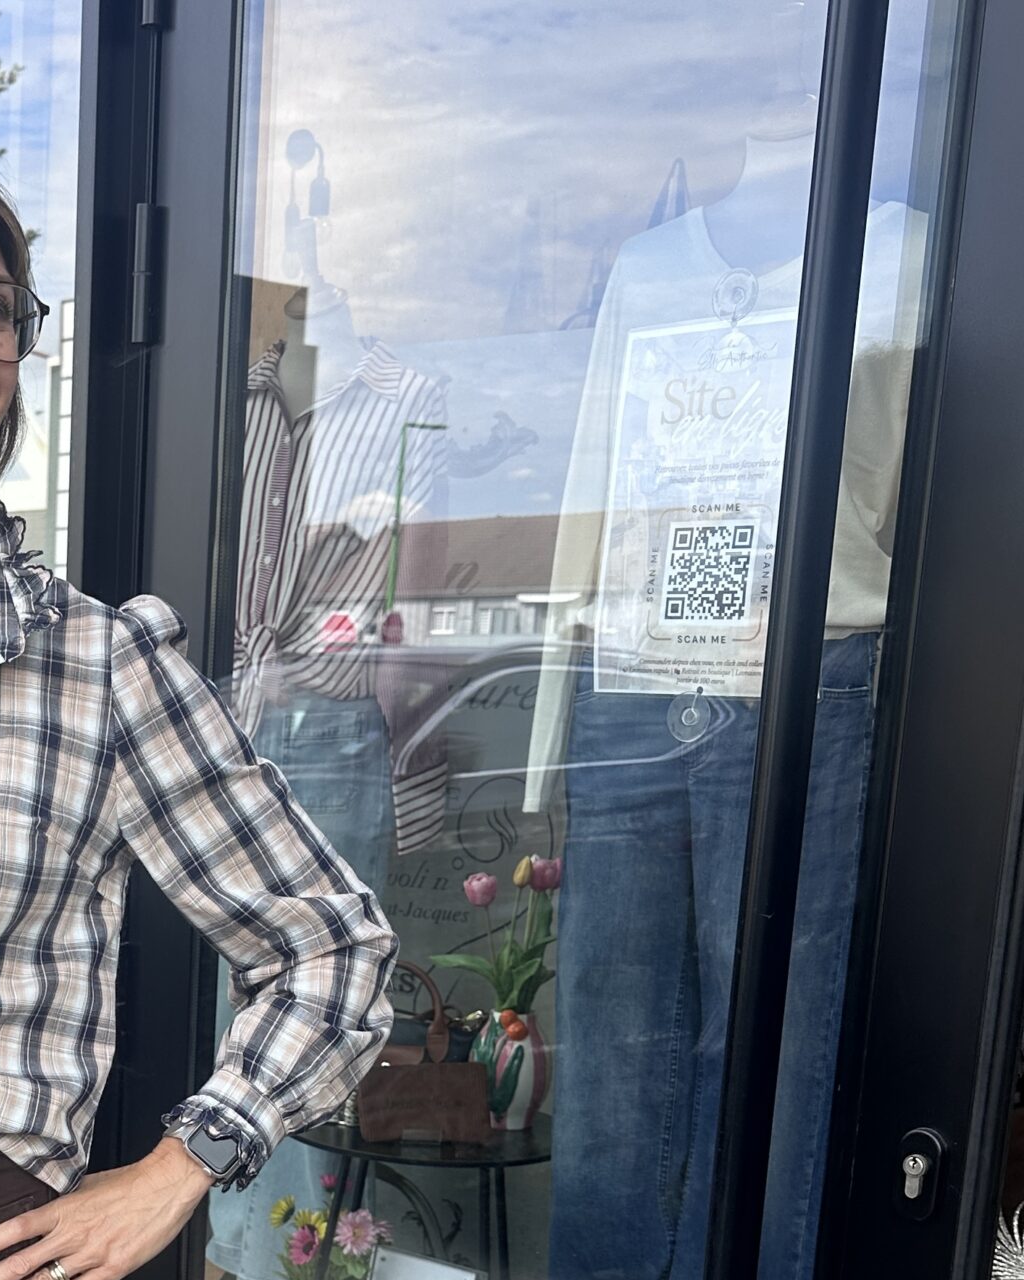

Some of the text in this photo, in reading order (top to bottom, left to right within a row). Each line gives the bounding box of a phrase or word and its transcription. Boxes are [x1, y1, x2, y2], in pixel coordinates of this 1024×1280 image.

[660, 378, 737, 425] Site
[672, 380, 786, 459] en lign
[691, 503, 741, 513] SCAN ME
[646, 547, 659, 602] SCAN ME
[760, 544, 773, 602] SCAN ME
[677, 635, 726, 644] SCAN ME
[387, 859, 428, 888] voli
